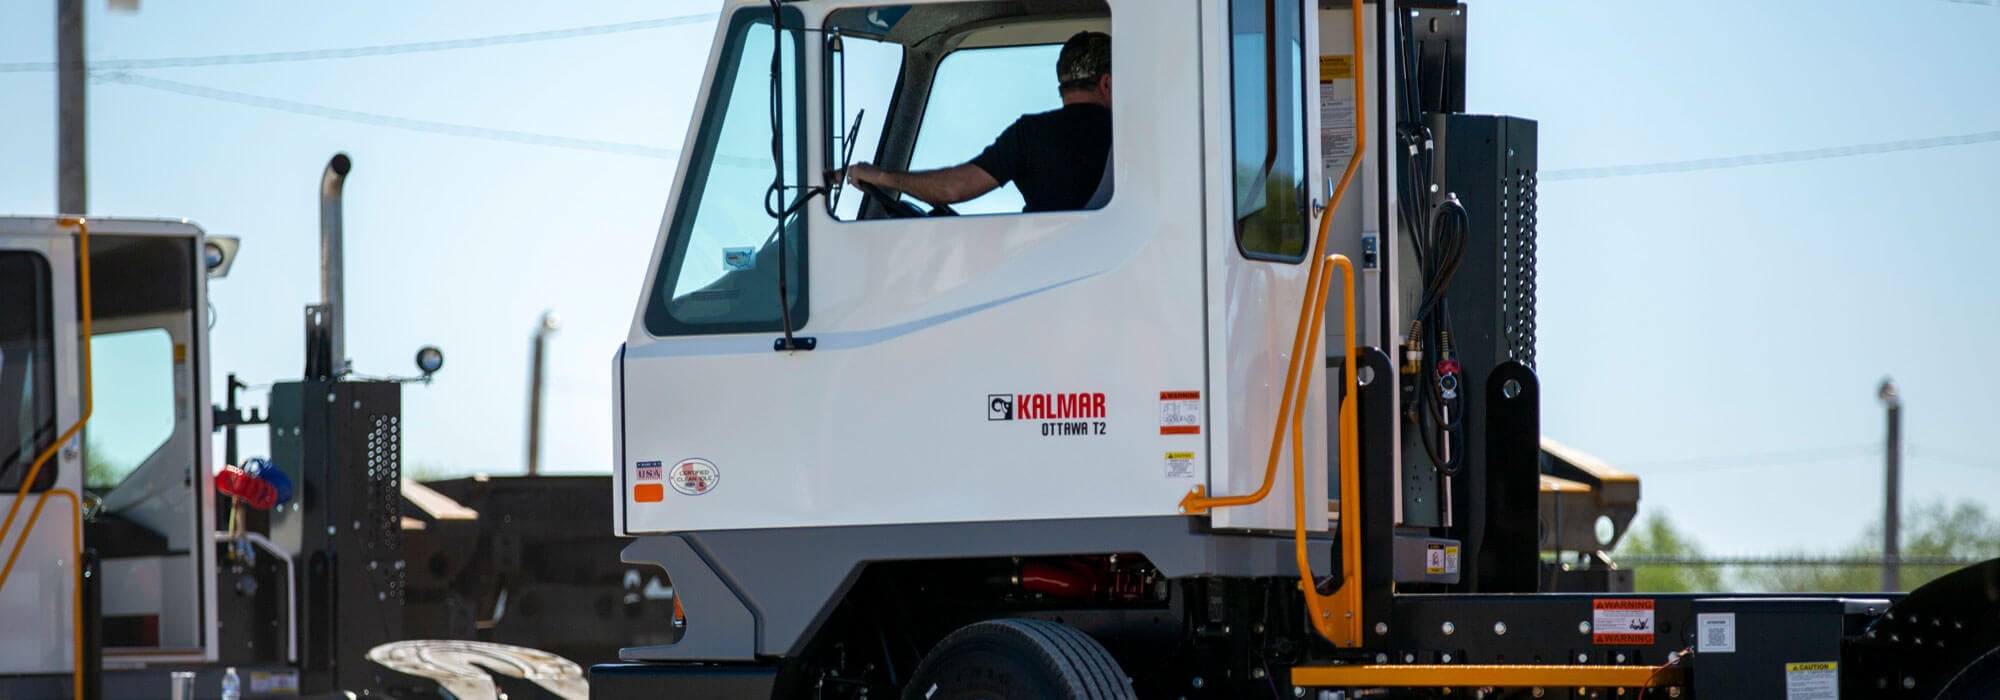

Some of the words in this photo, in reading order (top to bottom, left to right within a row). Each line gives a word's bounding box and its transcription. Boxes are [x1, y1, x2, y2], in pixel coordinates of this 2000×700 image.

[1017, 393, 1106, 420] KALMAR
[1042, 422, 1088, 436] OTTAWA
[1093, 422, 1106, 435] T2
[638, 469, 661, 479] USA
[1605, 599, 1653, 609] WARNING
[1605, 633, 1653, 643] WARNING
[1799, 663, 1829, 671] CAUTION
